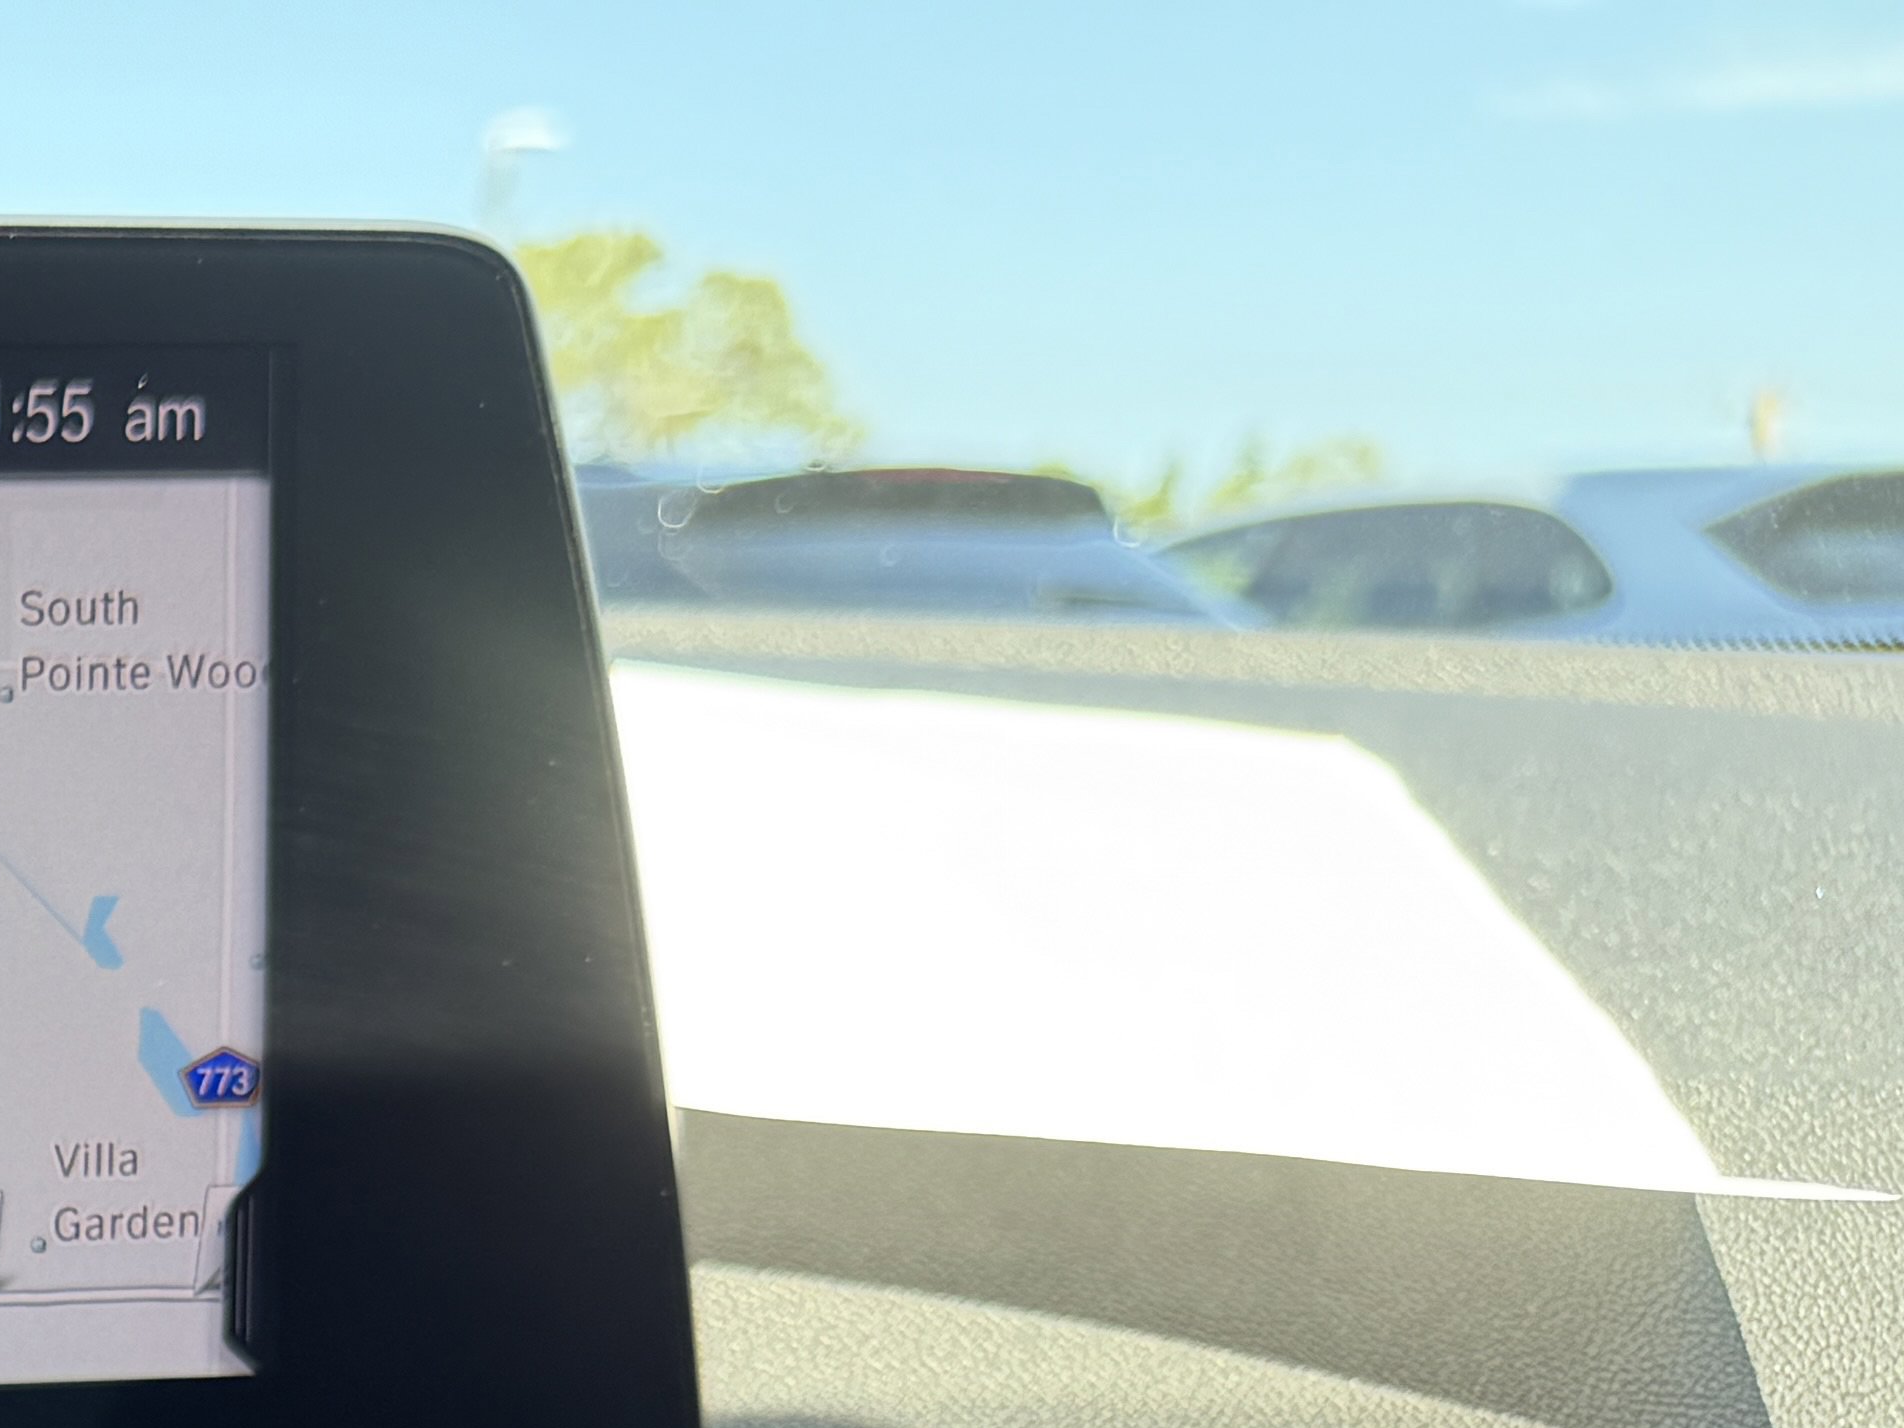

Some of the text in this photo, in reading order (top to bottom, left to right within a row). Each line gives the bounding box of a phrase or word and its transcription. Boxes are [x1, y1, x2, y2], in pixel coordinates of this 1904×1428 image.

[126, 395, 206, 441] am
[20, 590, 140, 626] South
[21, 654, 270, 692] Pointe Woo
[196, 1066, 249, 1096] 773
[55, 1142, 138, 1178] Villa
[54, 1204, 200, 1242] Garden
